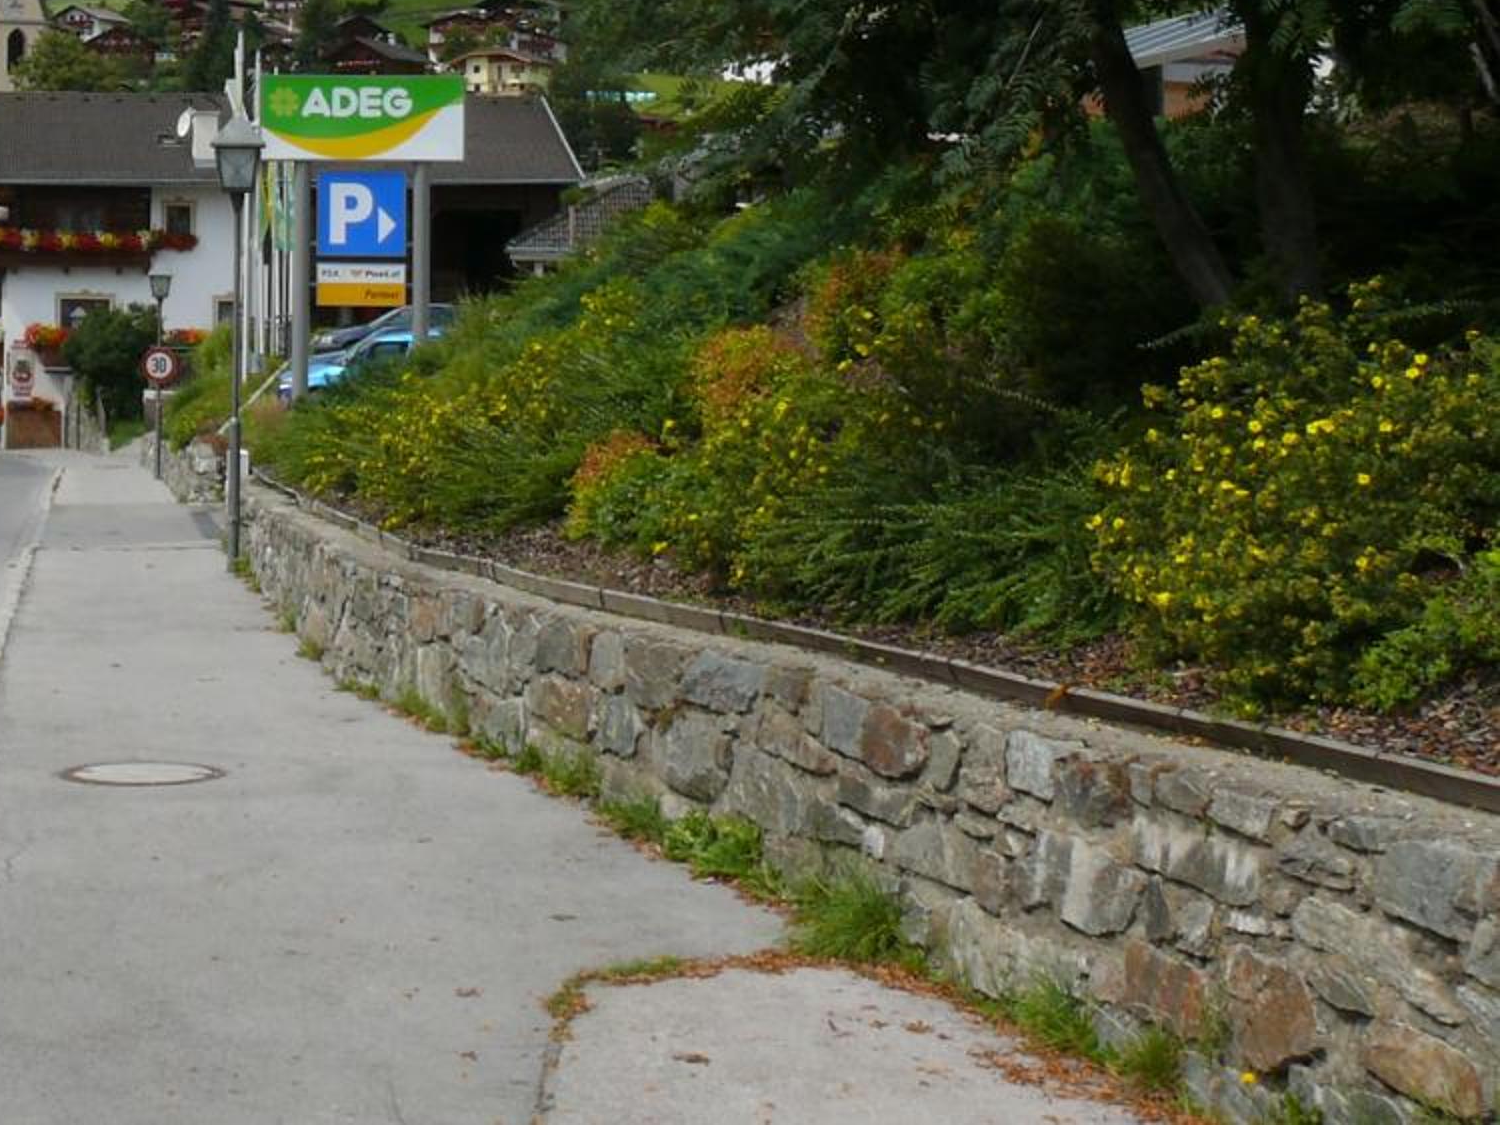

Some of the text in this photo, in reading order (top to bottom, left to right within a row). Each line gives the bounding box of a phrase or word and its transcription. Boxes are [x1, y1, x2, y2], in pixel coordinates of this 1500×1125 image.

[301, 87, 413, 118] ADEG
[329, 182, 373, 245] P
[151, 357, 167, 374] 30
